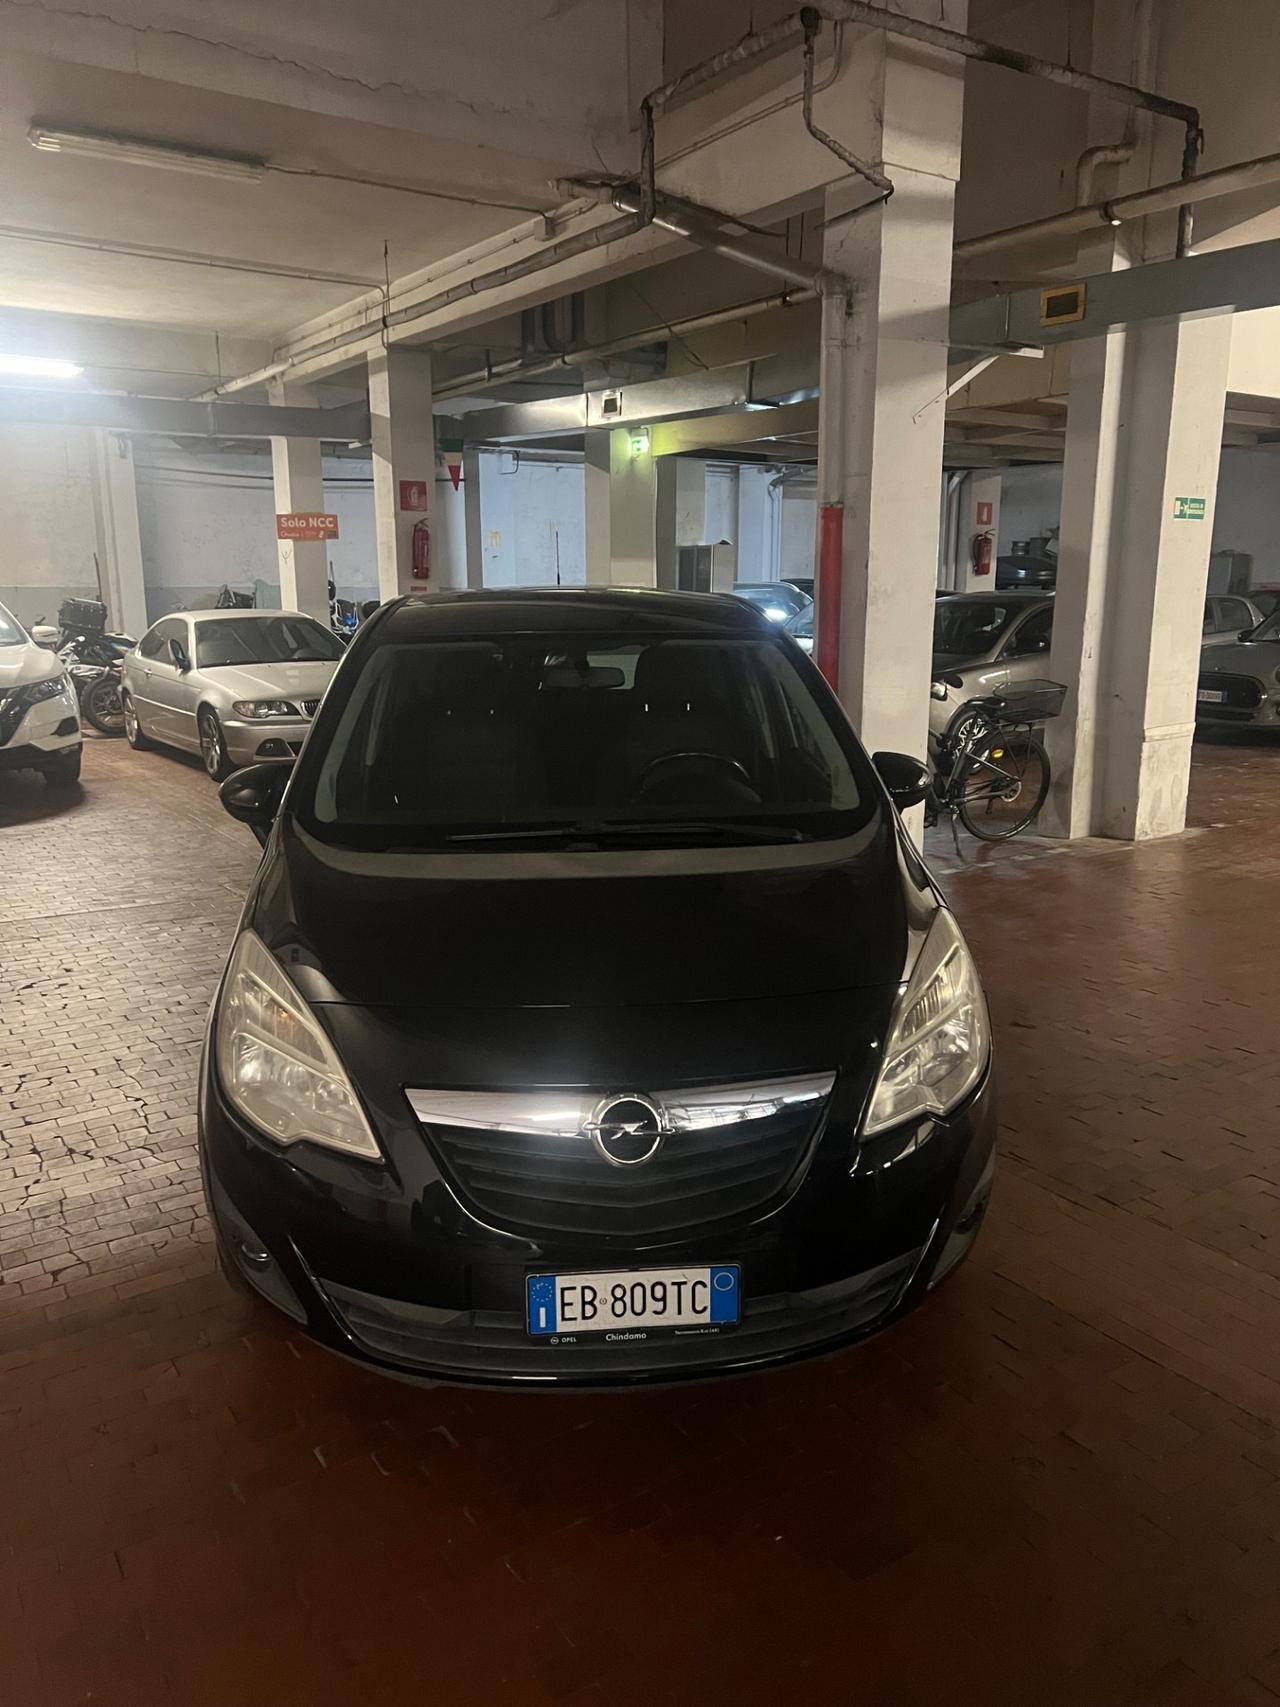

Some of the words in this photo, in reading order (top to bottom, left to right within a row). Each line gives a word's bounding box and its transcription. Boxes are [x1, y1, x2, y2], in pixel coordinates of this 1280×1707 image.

[281, 517, 306, 528] Solo
[309, 517, 334, 528] NCC
[561, 1336, 577, 1344] OPEL
[605, 1331, 647, 1342] Chindamo
